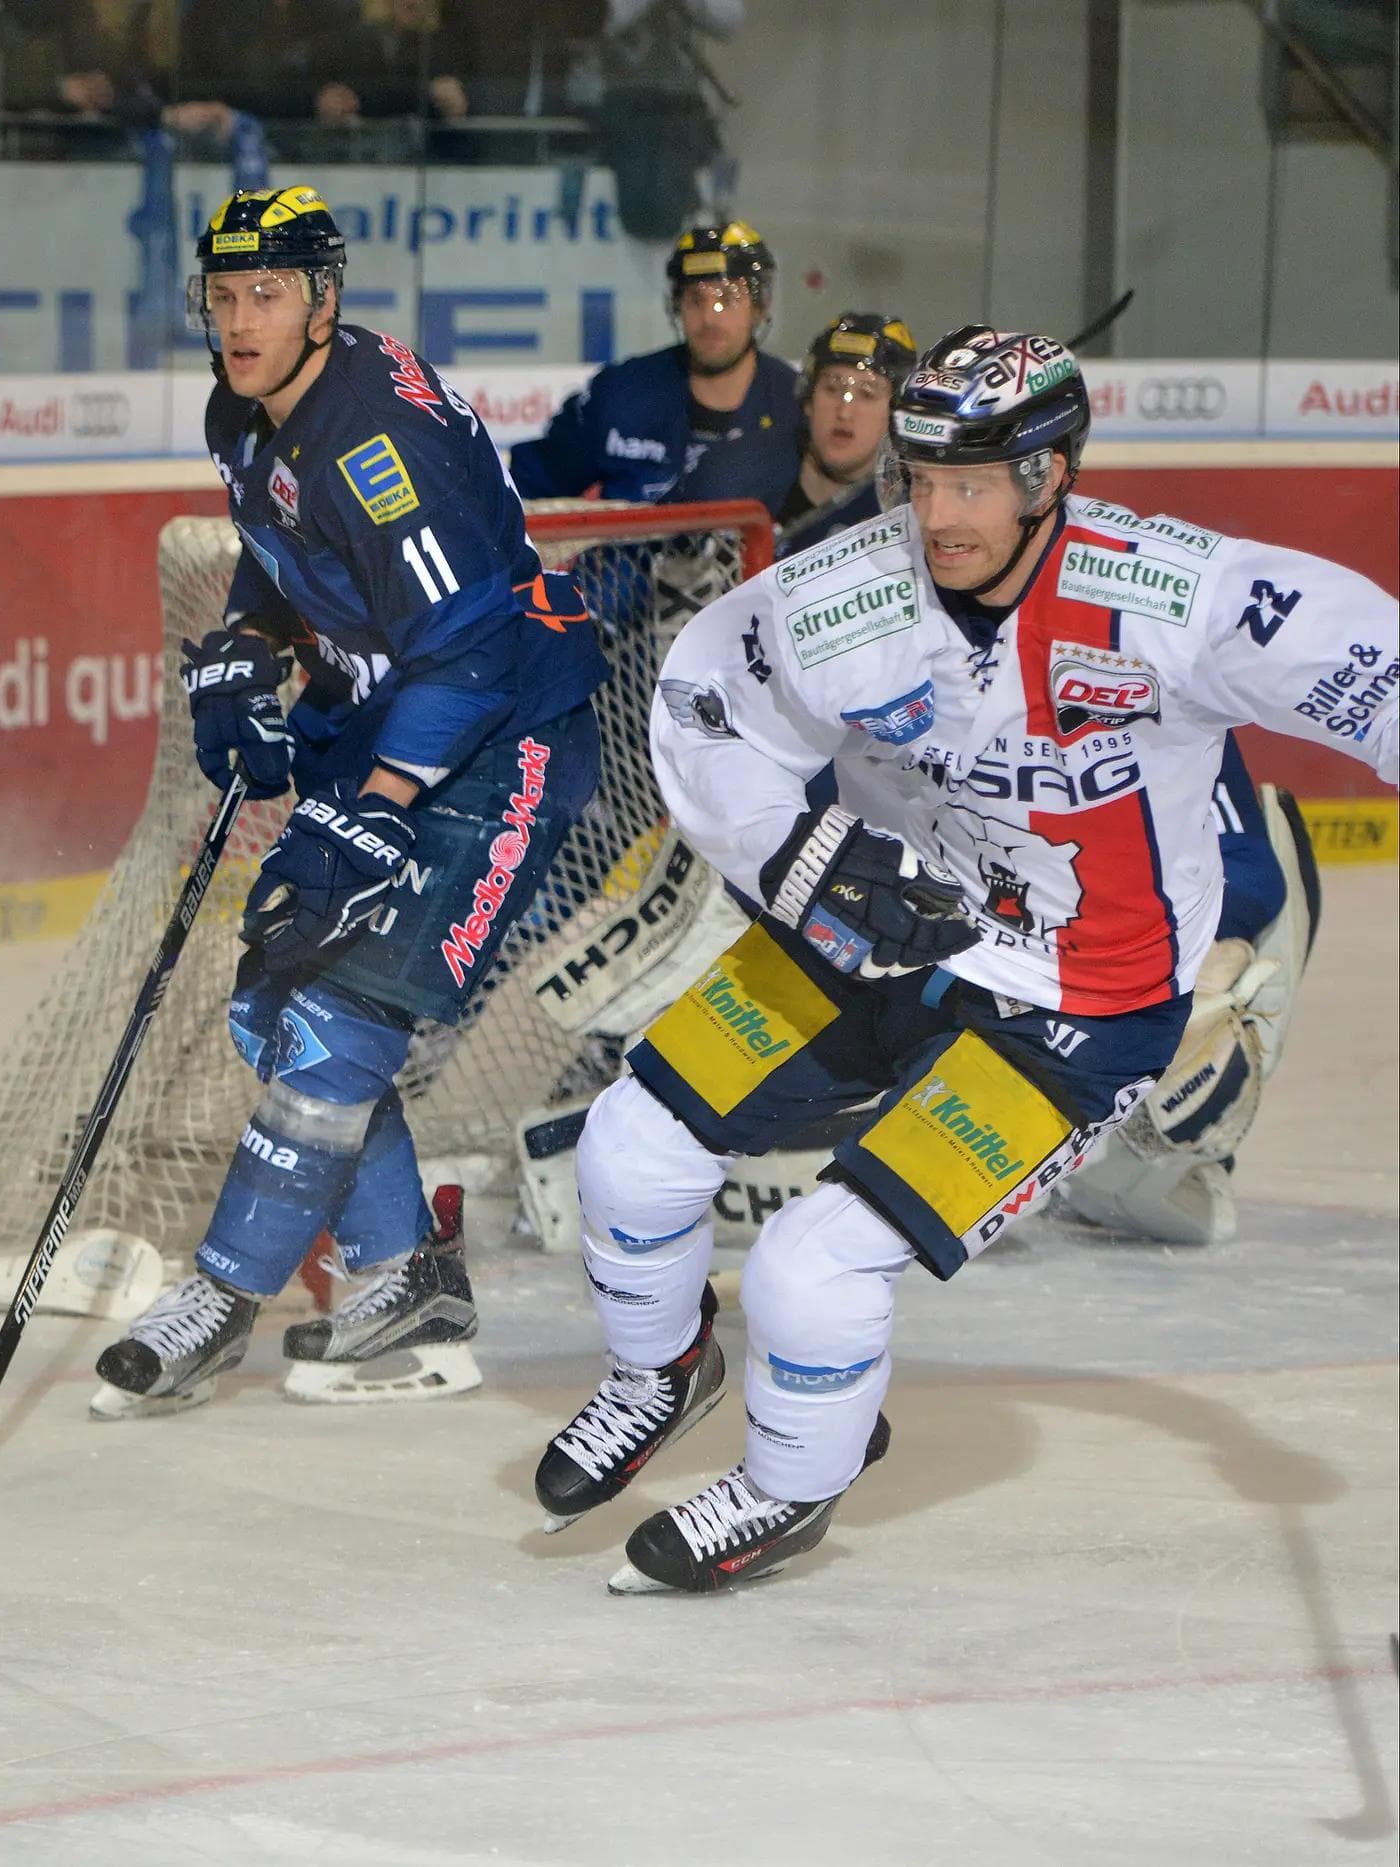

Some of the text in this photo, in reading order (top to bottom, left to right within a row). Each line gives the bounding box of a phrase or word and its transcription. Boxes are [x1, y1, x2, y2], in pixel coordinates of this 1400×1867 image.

[470, 387, 557, 427] Audi
[1089, 381, 1127, 419] di
[904, 416, 945, 436] tolina
[402, 526, 460, 604] 11
[1065, 549, 1191, 598] structure
[792, 579, 914, 643] structure
[1060, 578, 1168, 614] Bauträgergesellschaft
[801, 612, 902, 661] Bauträgergesellschaft
[185, 661, 255, 693] UER
[1058, 678, 1149, 710] DEL
[1294, 643, 1383, 722] Riller &
[1024, 739, 1069, 768] SEIT
[1081, 731, 1132, 759] 1995
[700, 975, 791, 1058] Knittel
[1161, 1062, 1218, 1114] VAUGHN
[929, 1094, 1026, 1181] Knittel
[12, 1195, 73, 1326] SUPREME
[731, 1549, 762, 1570] CCM
